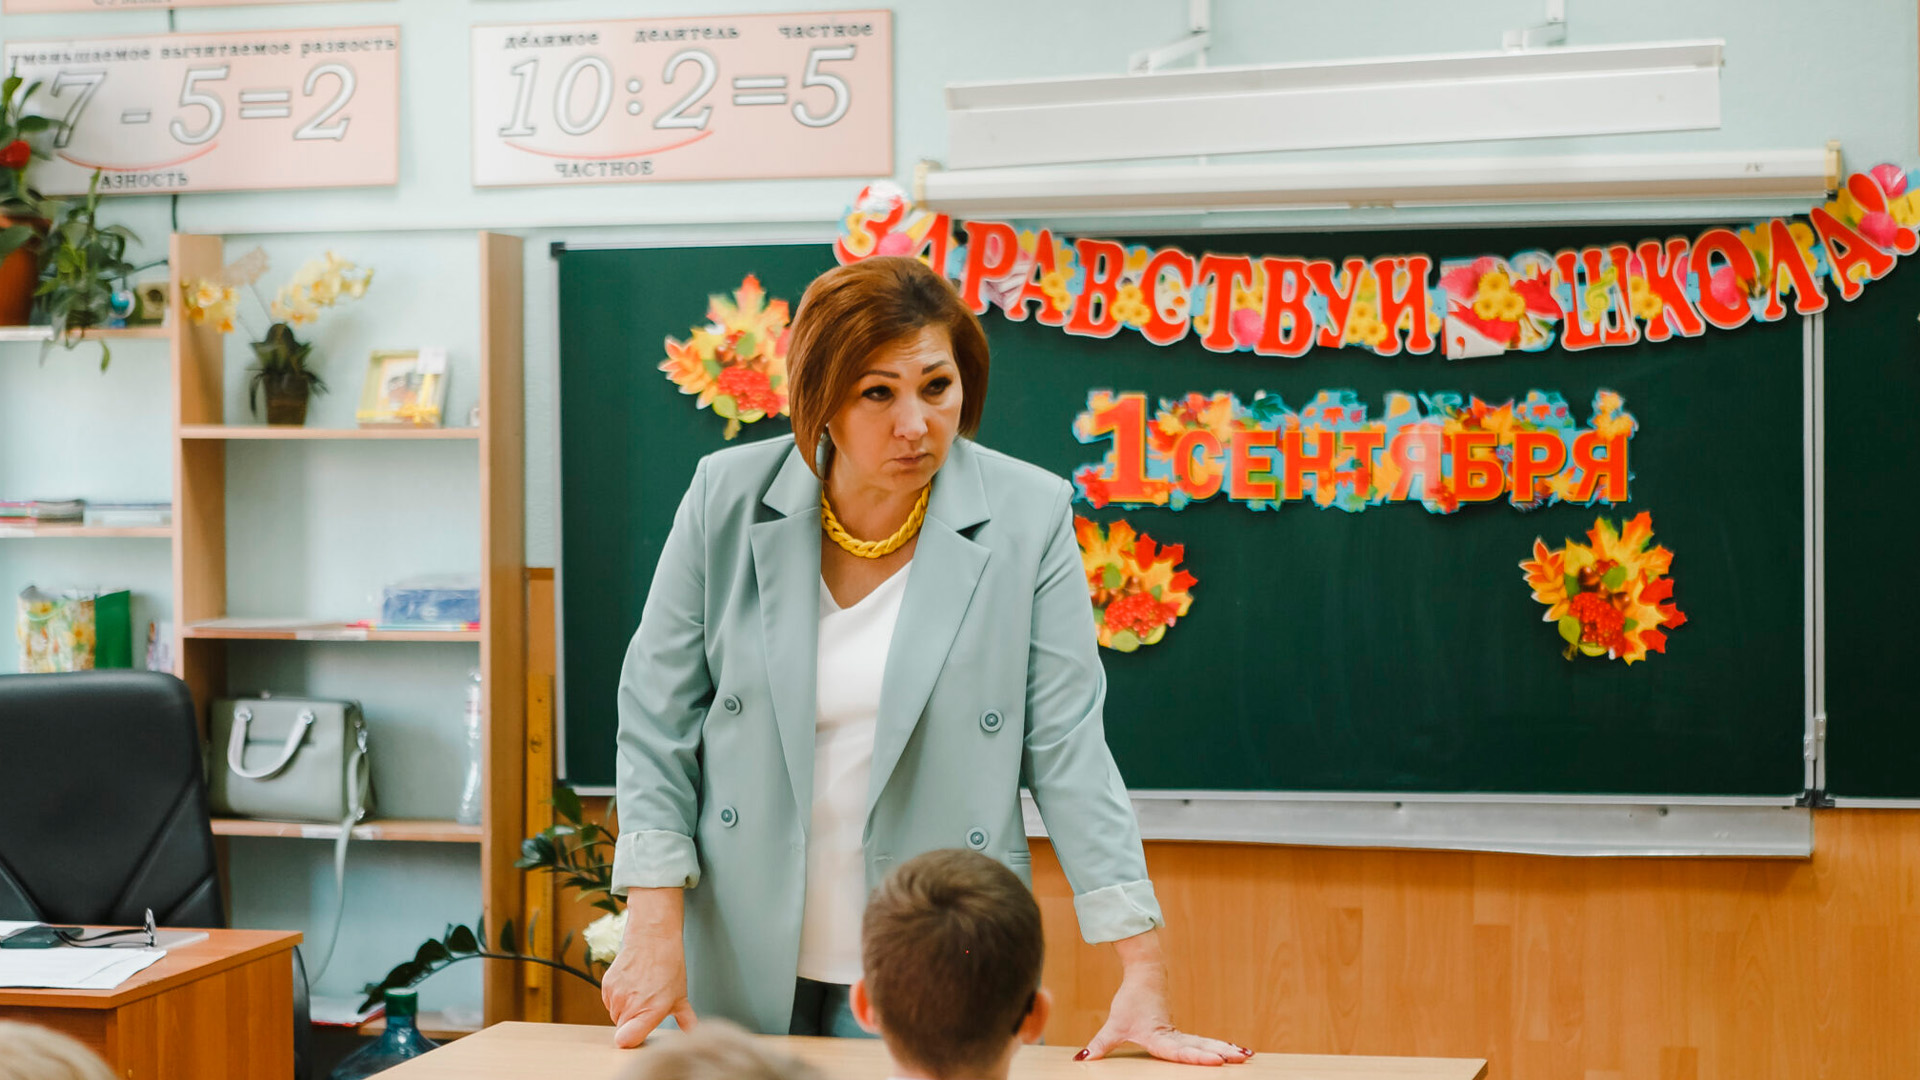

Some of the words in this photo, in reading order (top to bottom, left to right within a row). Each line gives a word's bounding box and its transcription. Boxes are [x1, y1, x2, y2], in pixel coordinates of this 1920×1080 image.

[634, 25, 741, 43] делитель
[778, 22, 874, 39] частное
[300, 37, 397, 58] разность
[555, 159, 655, 179] ЧАСТНОЕ
[99, 171, 189, 189] АЗНОСТЬ
[1094, 393, 1170, 504] 1
[1172, 429, 1630, 504] СЕНТЯБРЯ
